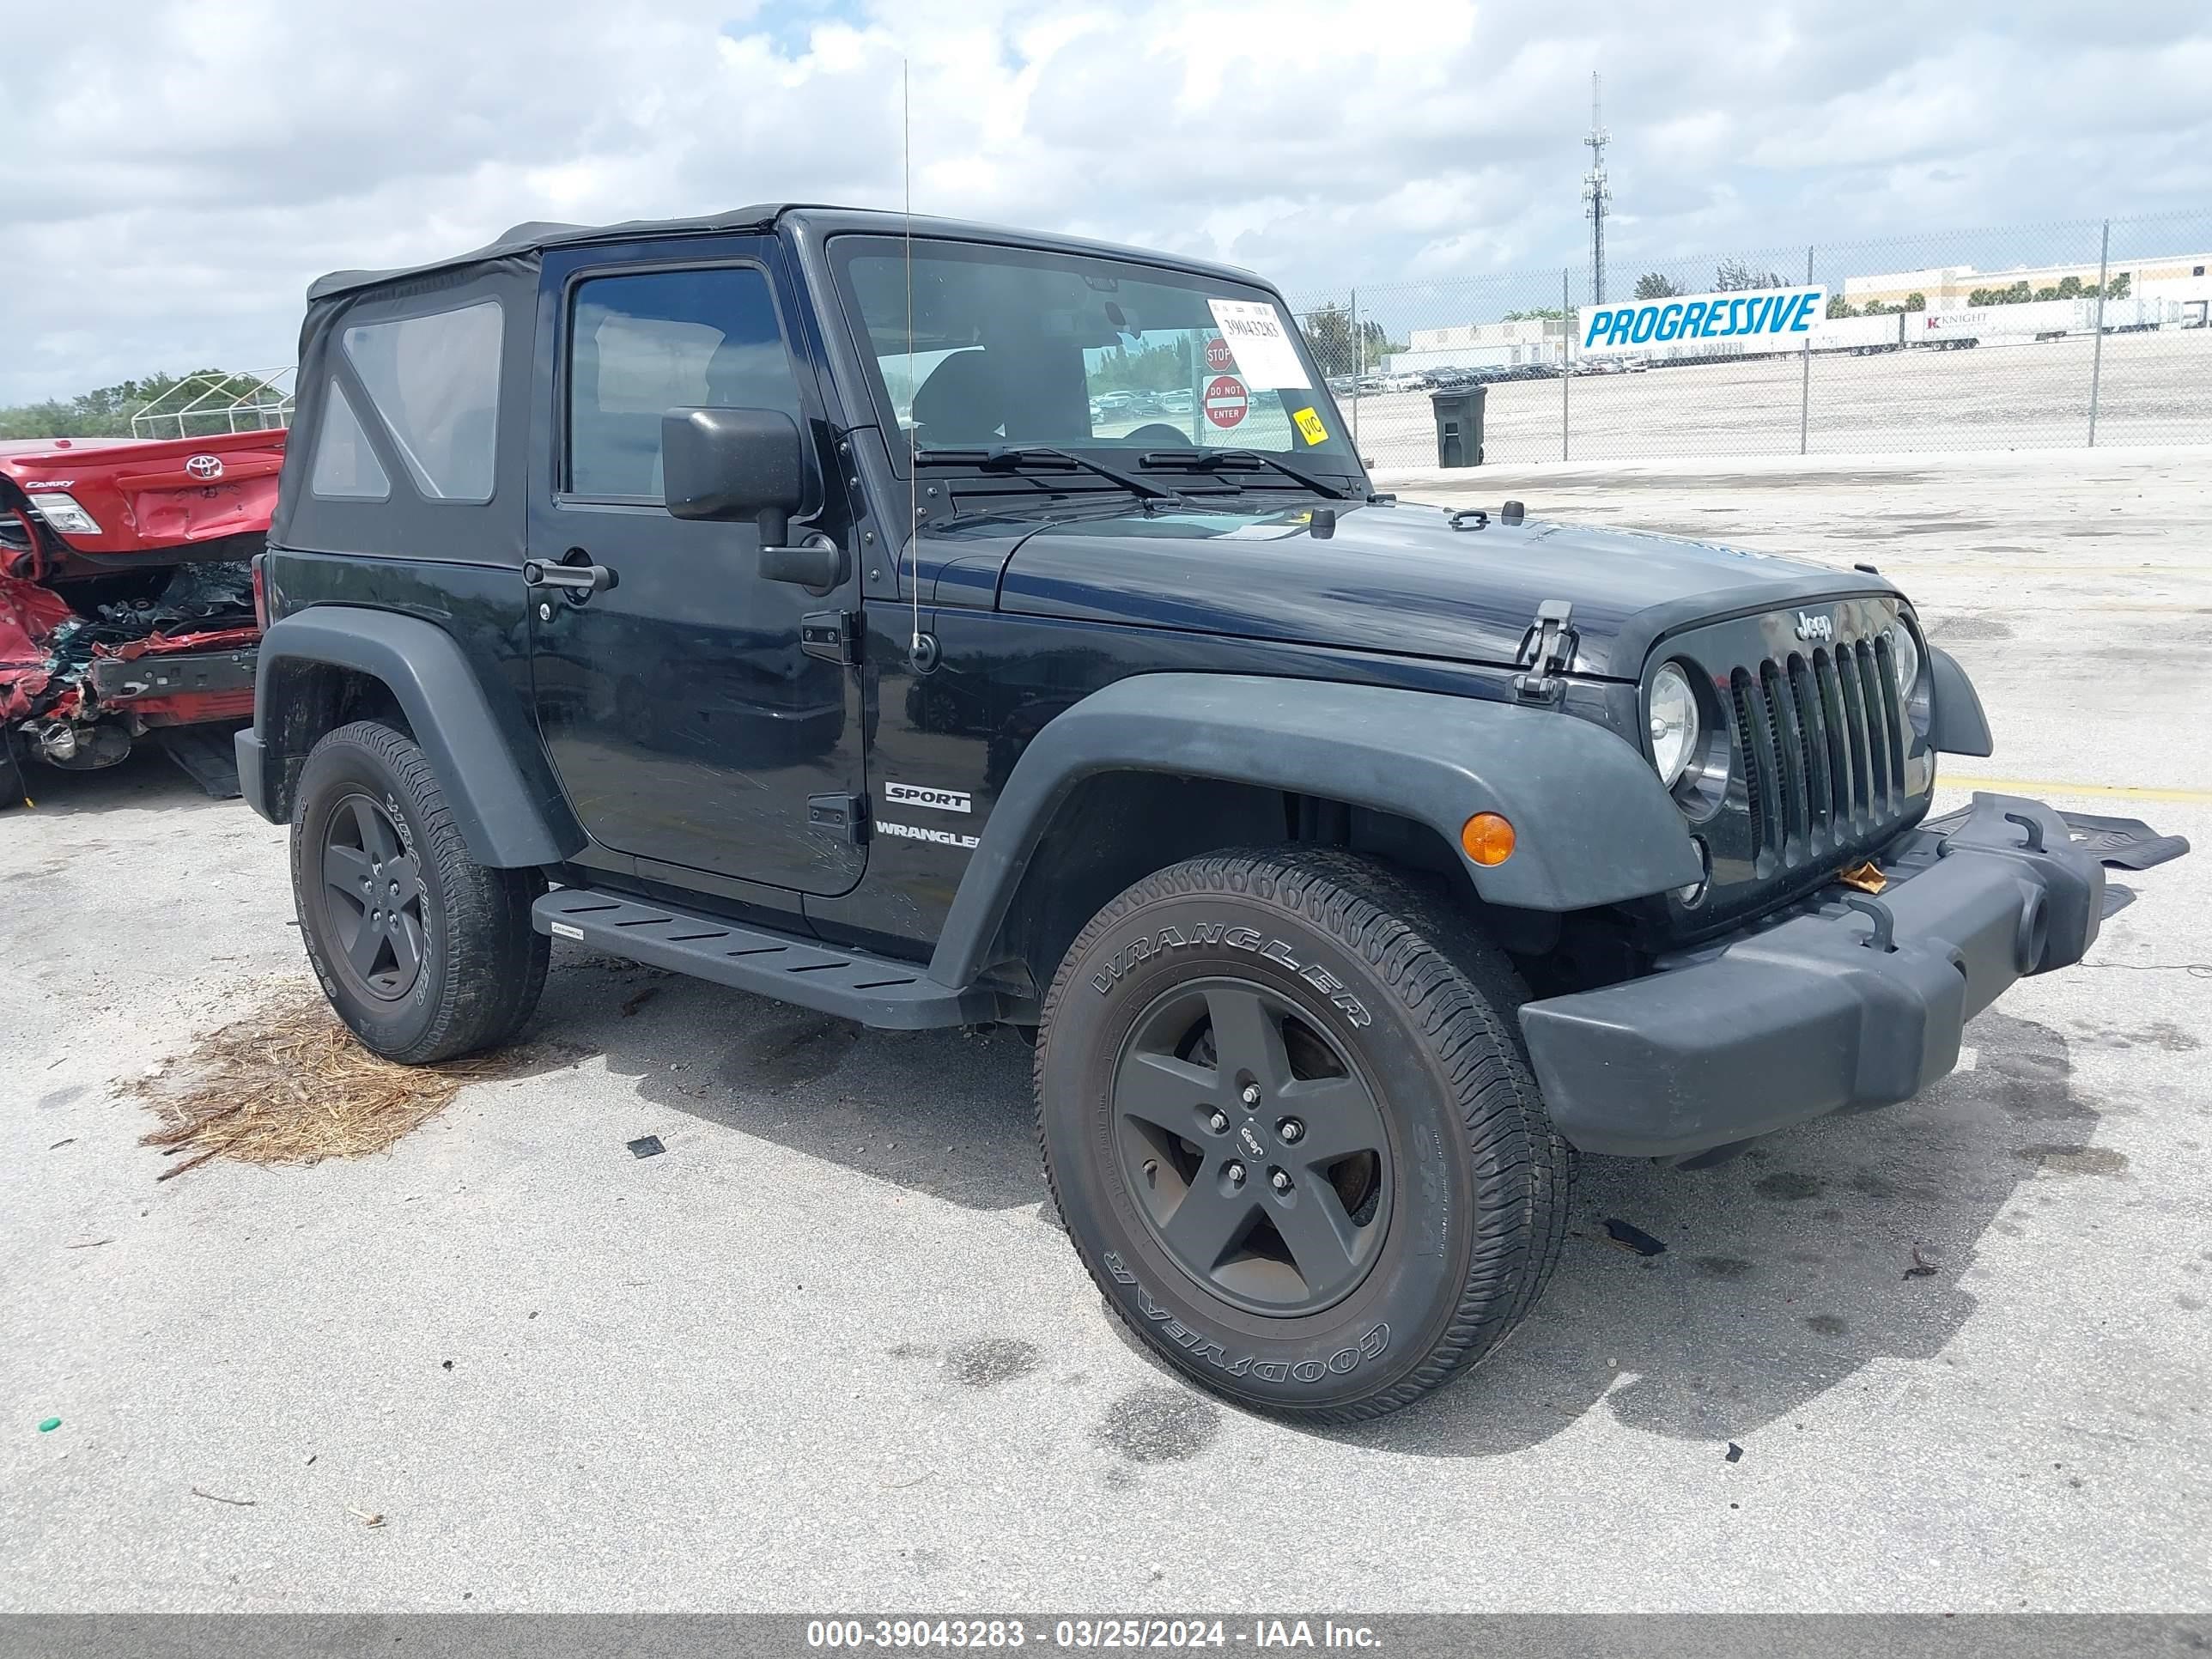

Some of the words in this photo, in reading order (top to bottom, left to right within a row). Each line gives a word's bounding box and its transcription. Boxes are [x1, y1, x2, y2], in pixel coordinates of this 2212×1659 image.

[1224, 319, 1279, 337] 39043283
[1584, 292, 1821, 349] PROGRESSIVE
[1942, 313, 1988, 325] KNIGHT
[1207, 348, 1231, 362] STOP
[1210, 386, 1222, 396] DO
[1224, 386, 1241, 395] NOT
[1213, 410, 1239, 419] ENTER
[1795, 611, 1832, 642] Jeep
[887, 787, 969, 807] SPORT
[1091, 921, 1373, 1030] WRANGLER
[1241, 1127, 1264, 1155] Jeep
[1103, 1249, 1392, 1383] GOODYEAR
